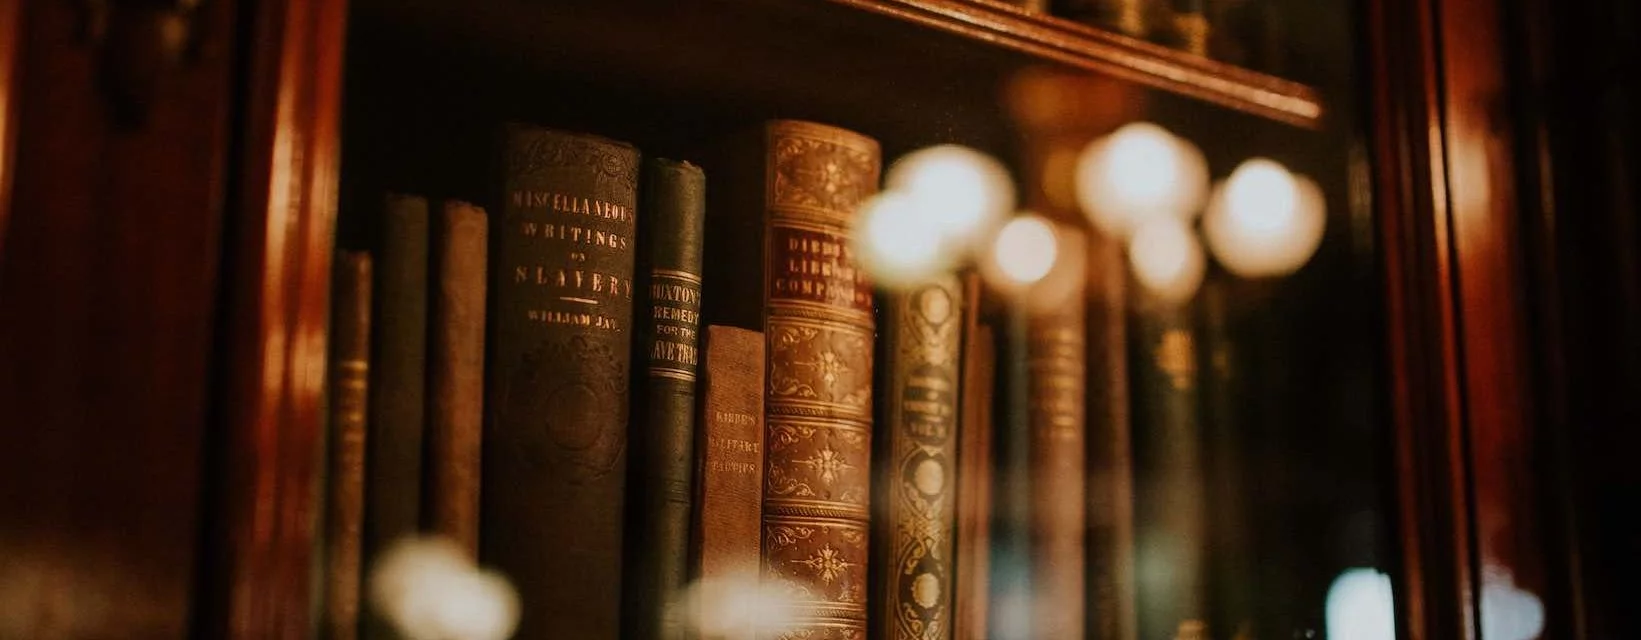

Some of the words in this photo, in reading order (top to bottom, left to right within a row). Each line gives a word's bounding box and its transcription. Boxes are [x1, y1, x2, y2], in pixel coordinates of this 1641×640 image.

[522, 222, 627, 250] WRITINGS
[515, 265, 632, 298] SLAVERY
[527, 310, 591, 327] WILLIAM
[652, 305, 700, 326] REMEDY
[656, 324, 679, 337] FOR
[680, 327, 697, 341] THE
